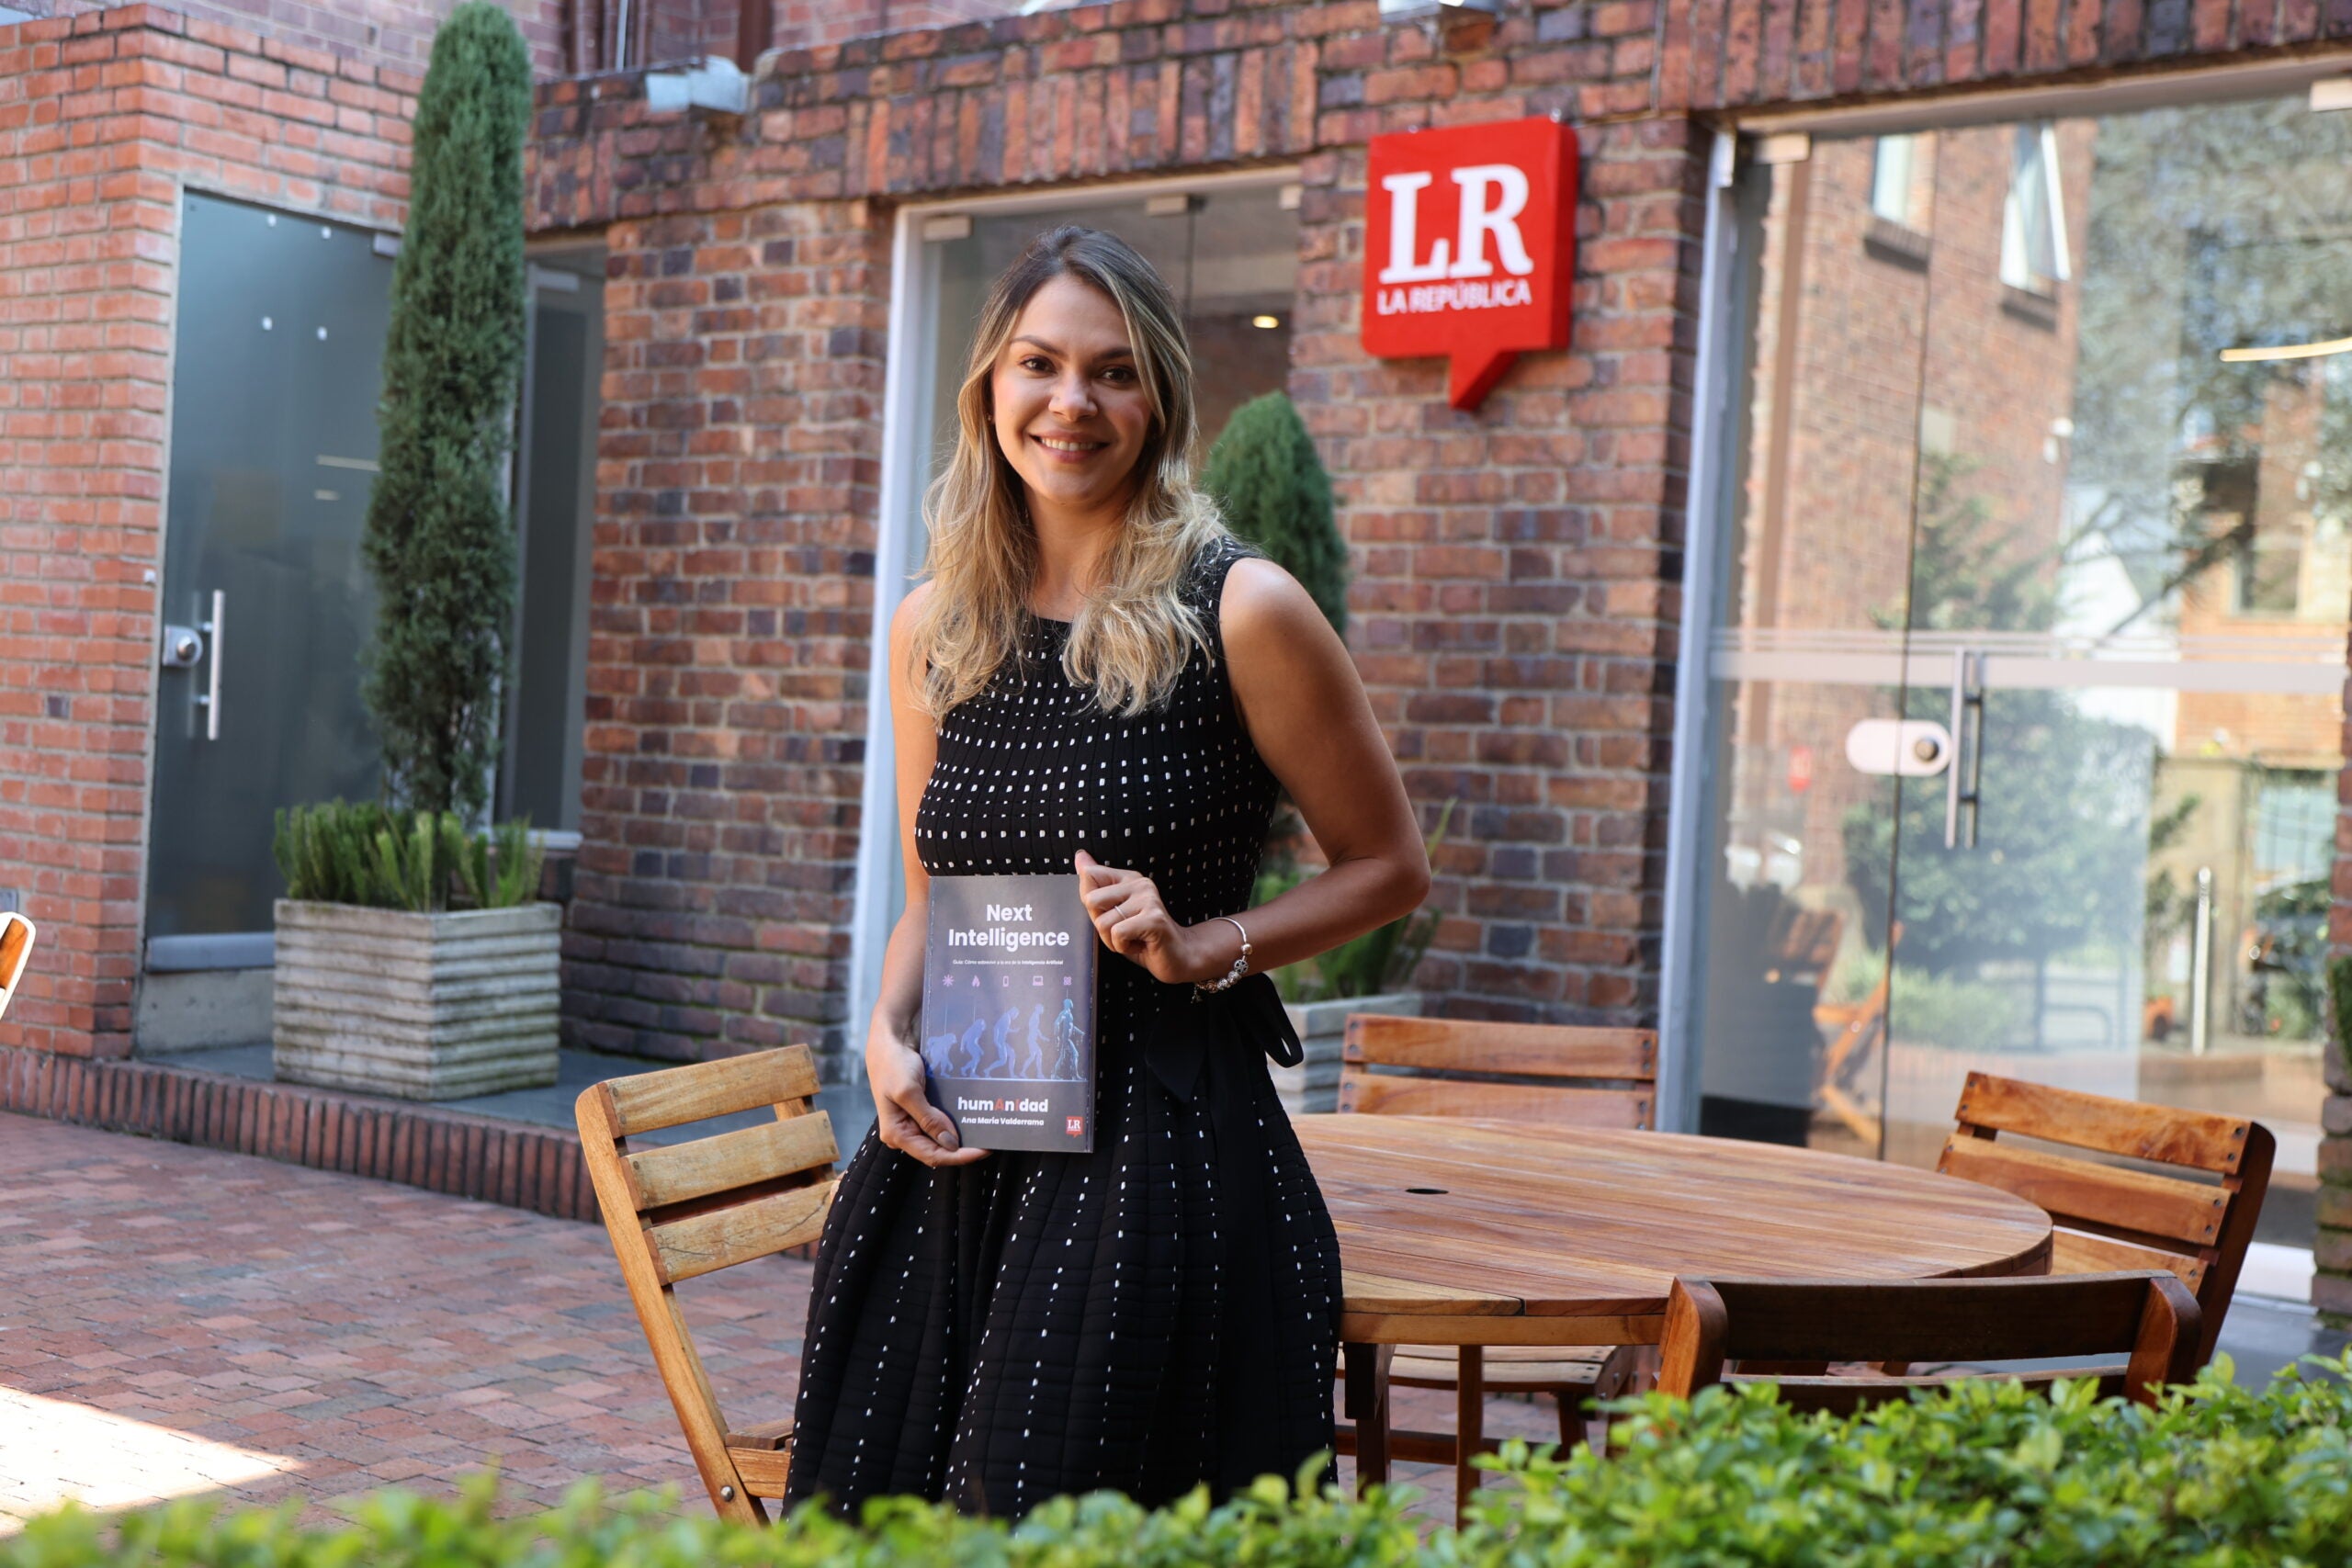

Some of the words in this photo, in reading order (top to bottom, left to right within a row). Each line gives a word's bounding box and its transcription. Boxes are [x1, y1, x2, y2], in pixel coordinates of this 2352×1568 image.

[1379, 164, 1534, 284] LR
[1377, 288, 1408, 315] LA
[1408, 278, 1532, 313] REPÚBLICA
[986, 904, 1033, 921] Next
[948, 927, 1069, 952] Intelligence
[961, 1116, 977, 1124] Ana
[978, 1116, 1000, 1125] María
[1001, 1117, 1045, 1126] Valderrama
[1067, 1119, 1080, 1130] LR
